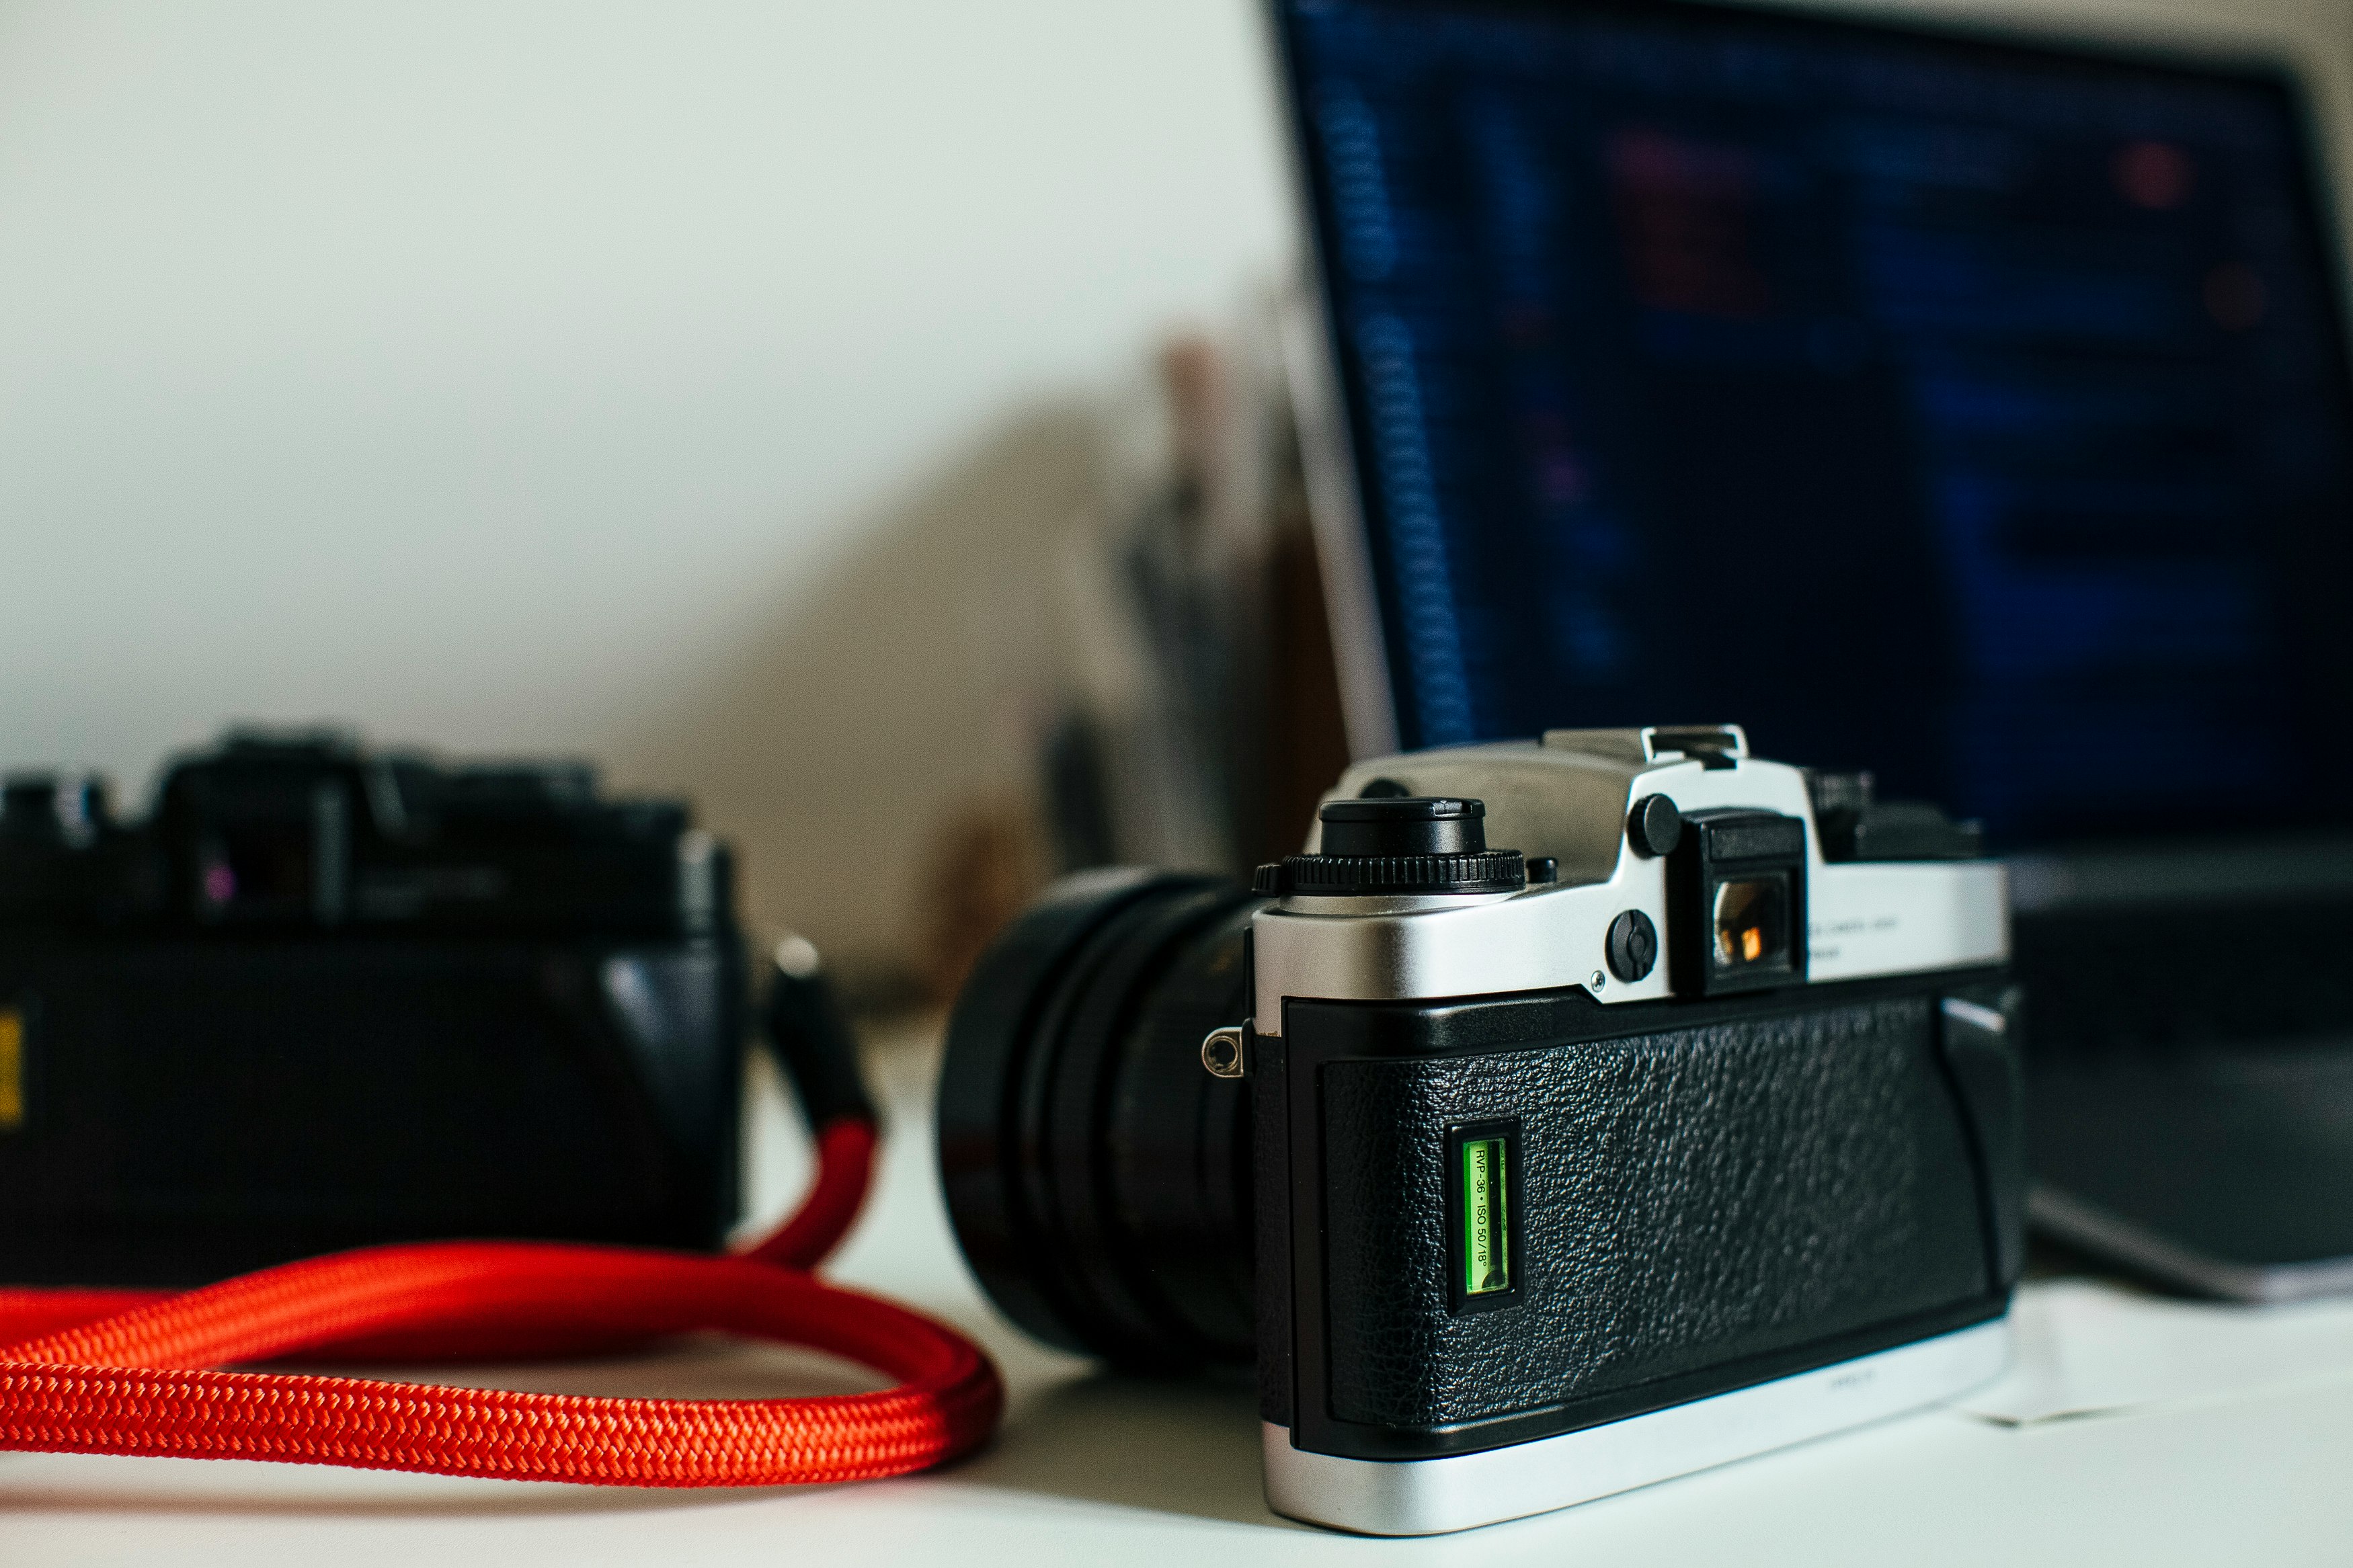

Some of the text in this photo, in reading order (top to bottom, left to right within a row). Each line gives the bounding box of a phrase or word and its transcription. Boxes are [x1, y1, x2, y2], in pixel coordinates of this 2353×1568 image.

[1476, 1149, 1487, 1267] RVP-36 ISO 50/18°
